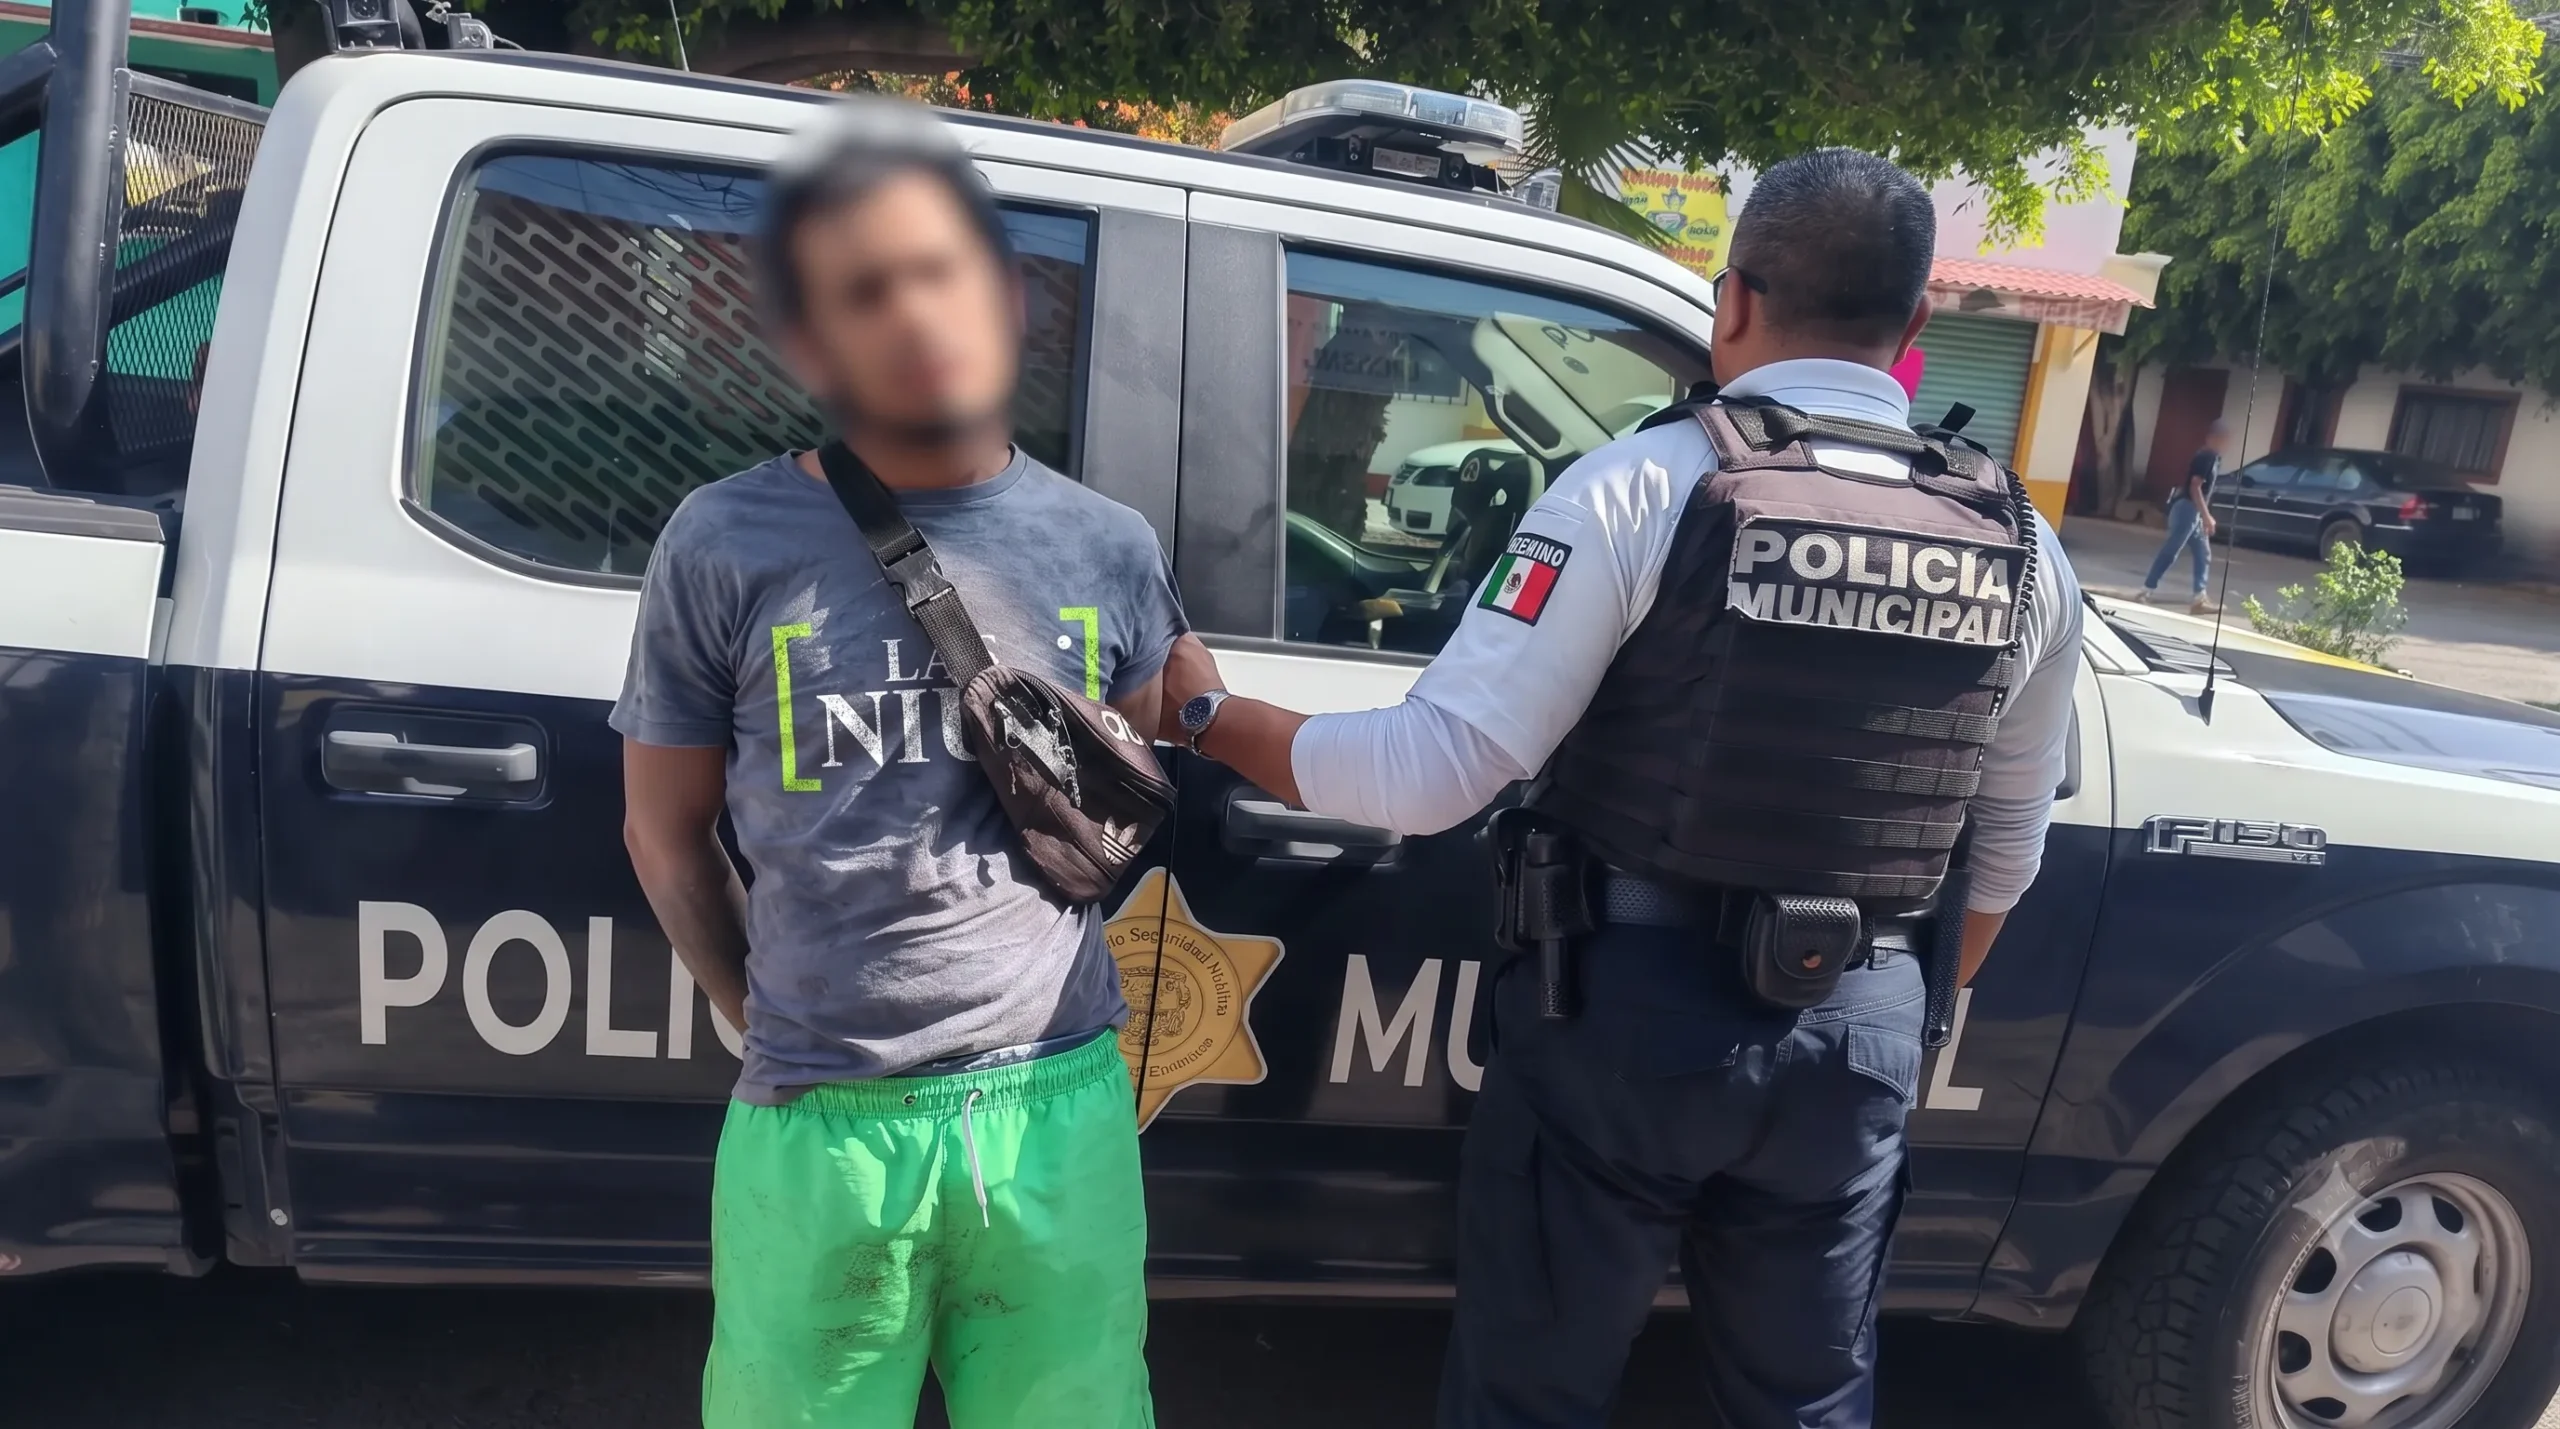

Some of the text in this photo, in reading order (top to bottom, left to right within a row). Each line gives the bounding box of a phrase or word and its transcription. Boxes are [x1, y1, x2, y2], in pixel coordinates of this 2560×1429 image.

[1735, 527, 2011, 604] POLICÍA
[1731, 581, 2006, 645] MUNICIPAL
[358, 900, 745, 1062] POLI
